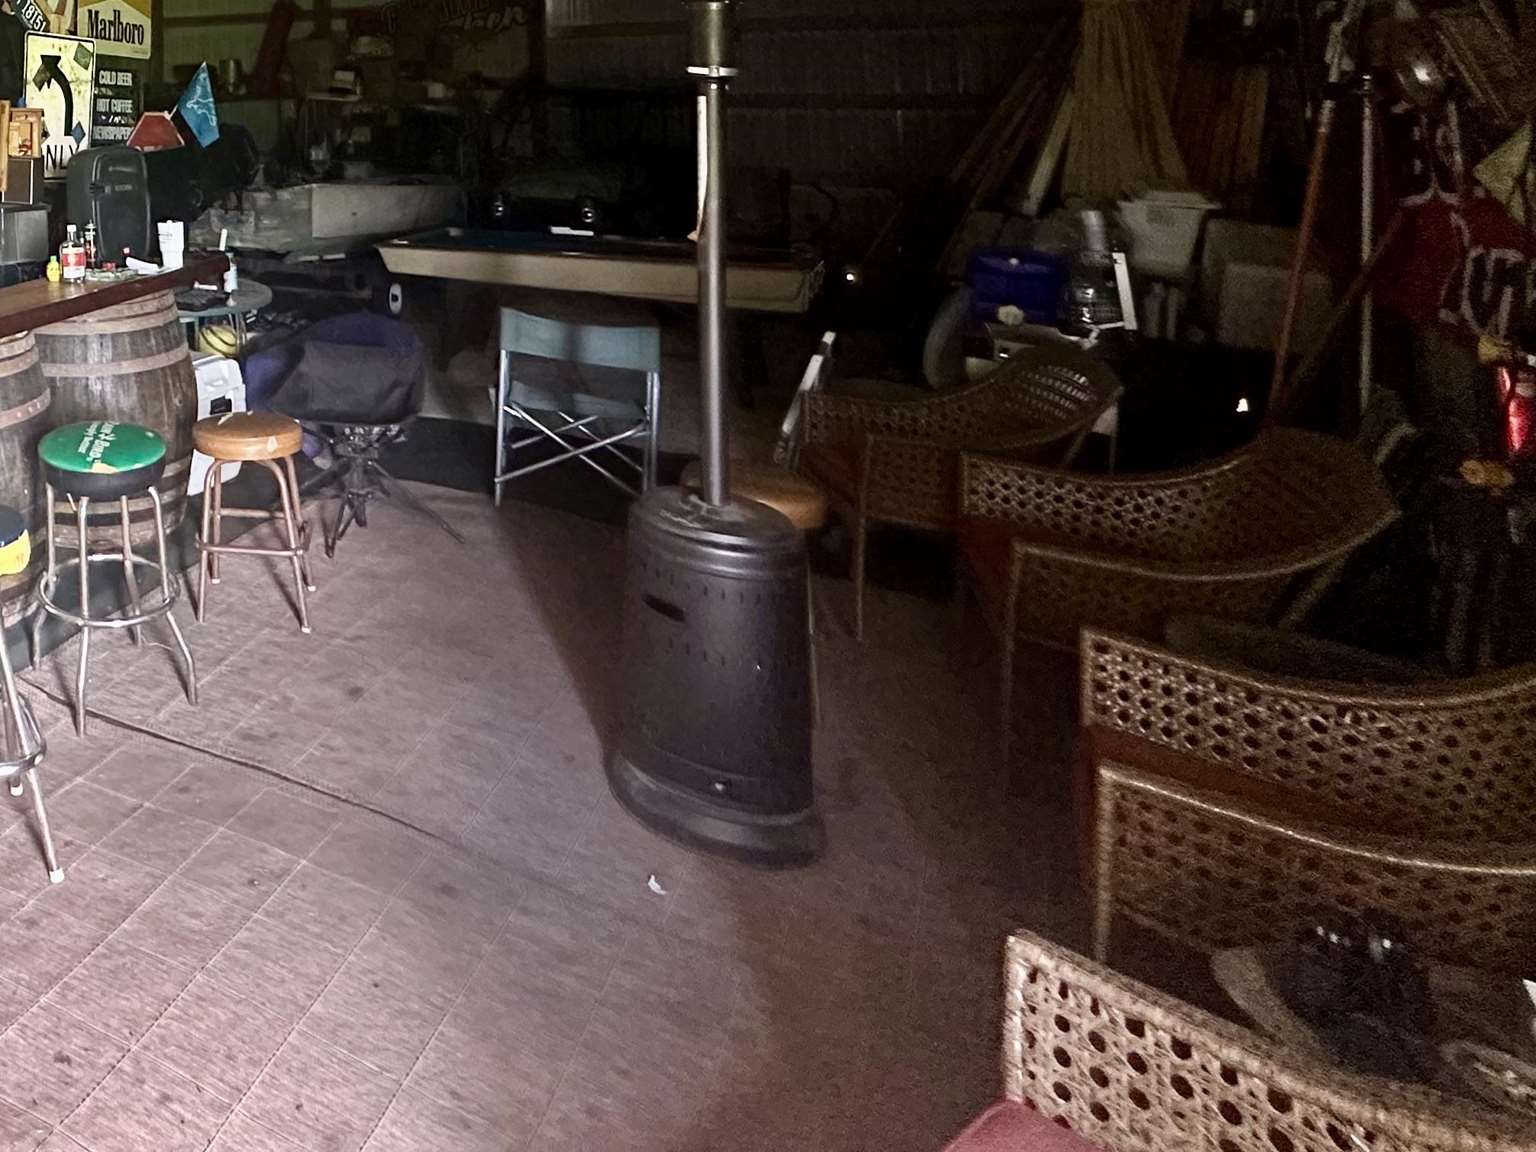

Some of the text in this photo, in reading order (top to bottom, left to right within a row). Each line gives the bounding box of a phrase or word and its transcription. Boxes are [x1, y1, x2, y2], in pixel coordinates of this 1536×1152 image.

[87, 9, 145, 45] Marlboro
[99, 70, 116, 85] COLD
[45, 144, 81, 171] NLY
